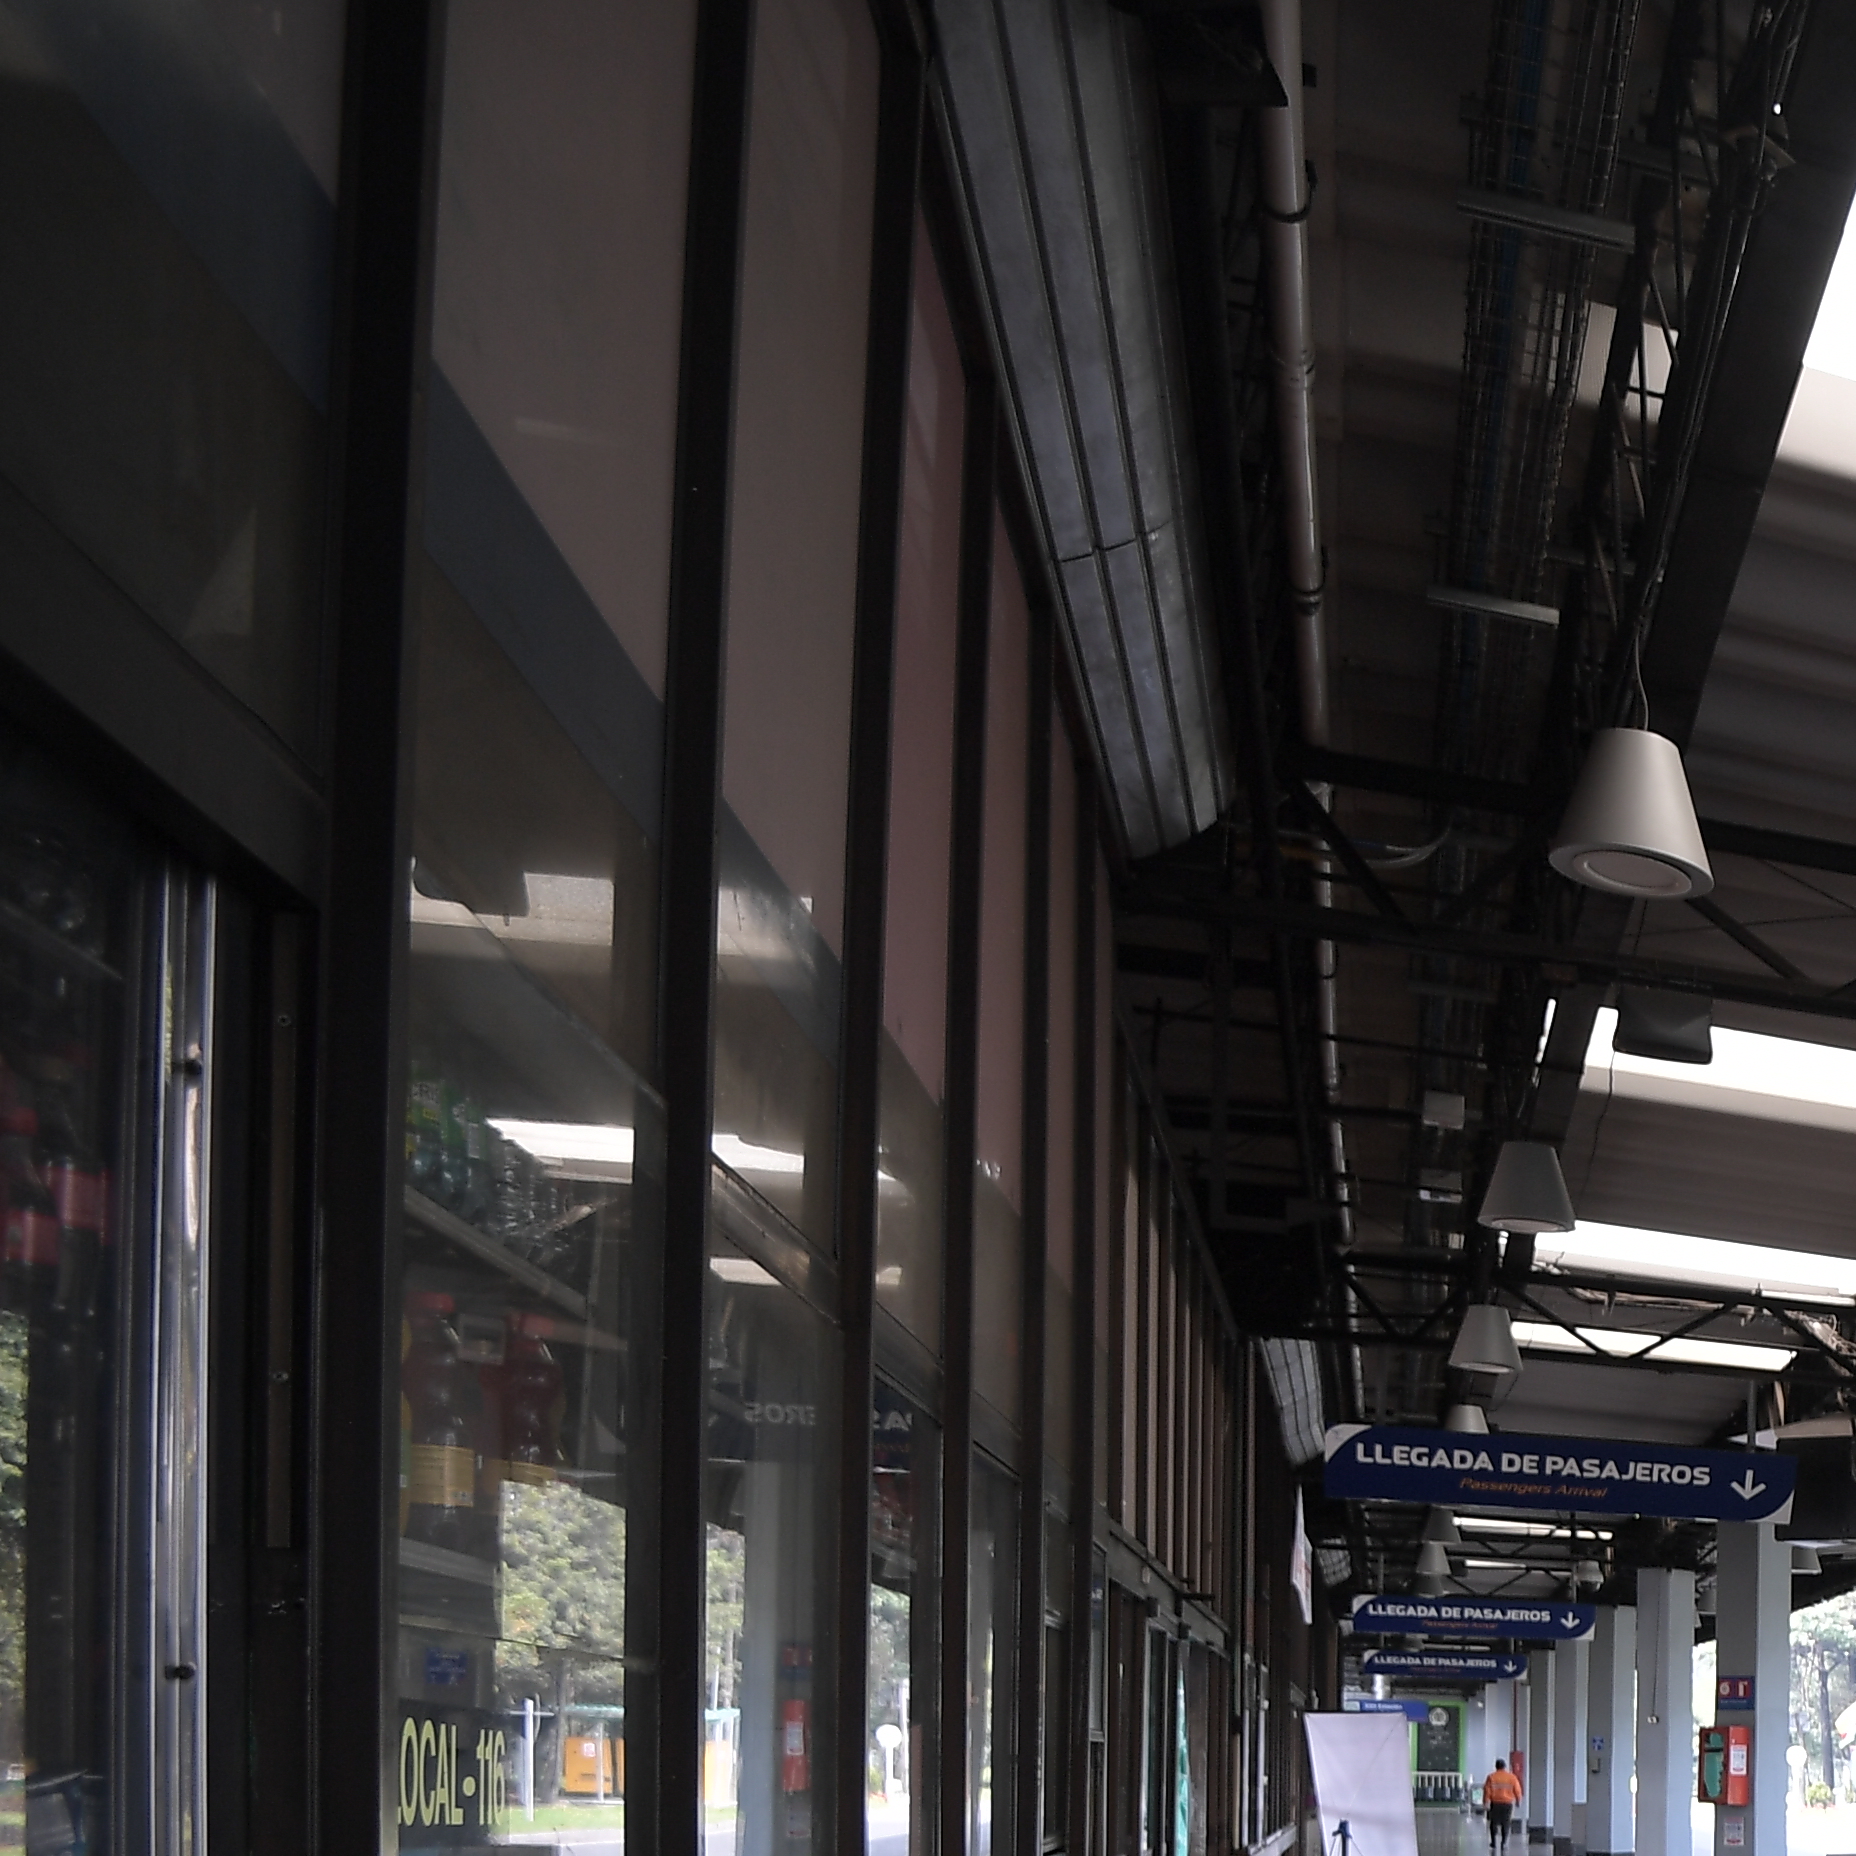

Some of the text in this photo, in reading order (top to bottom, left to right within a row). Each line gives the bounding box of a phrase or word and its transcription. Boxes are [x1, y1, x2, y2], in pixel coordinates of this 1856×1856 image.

[1355, 1442, 1711, 1486] LLEGADA DE PASAJEROS
[1459, 1476, 1608, 1498] Passengers Arrival
[1368, 1603, 1551, 1623] LLEGADA DE PASAJEROS
[1374, 1655, 1498, 1669] LLEGADA DE PASAJEROS
[398, 1716, 464, 1827] OCAL
